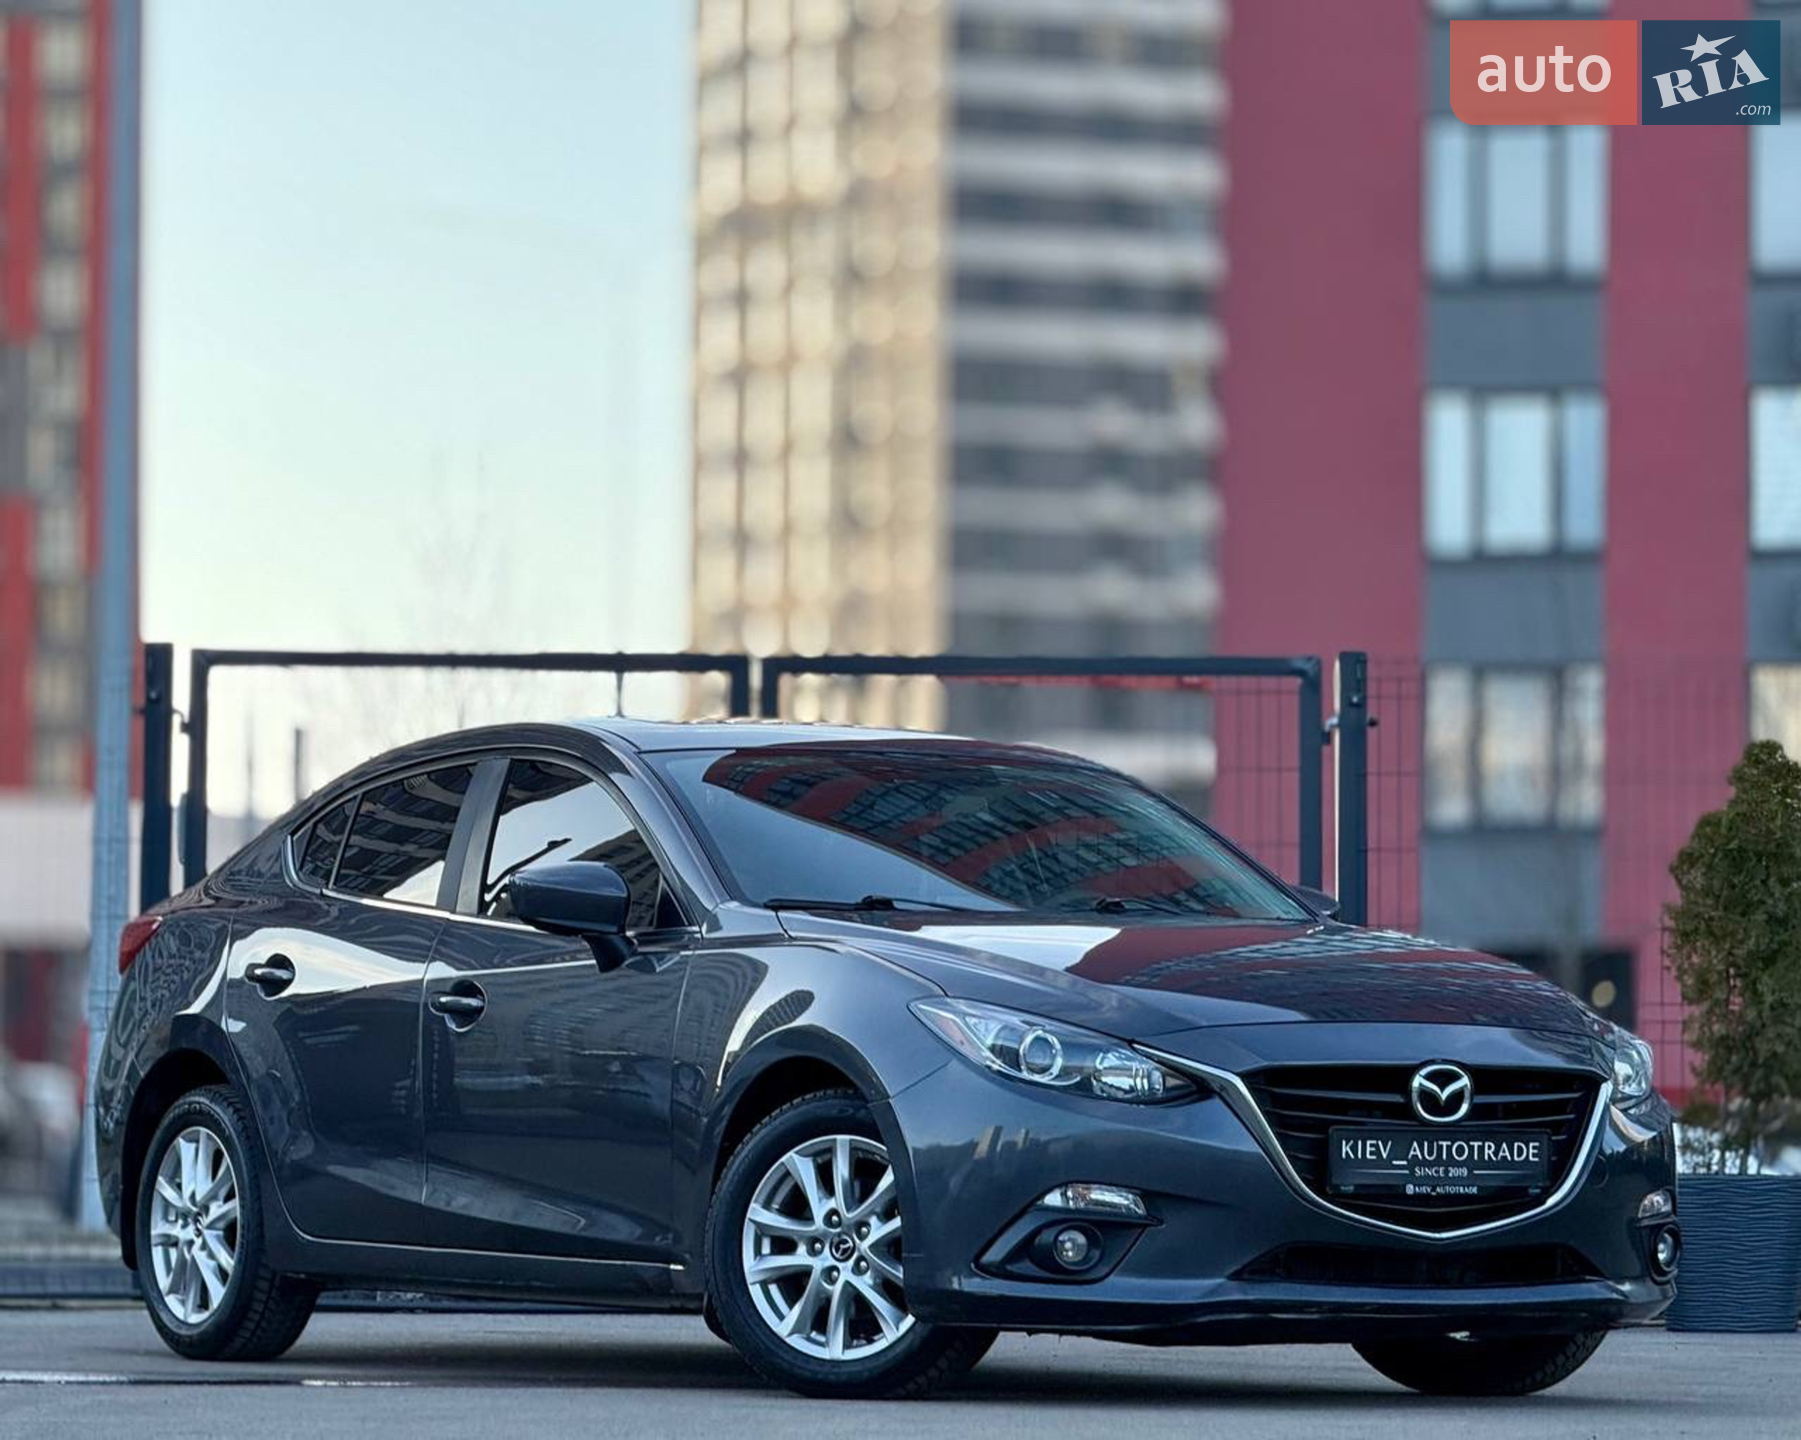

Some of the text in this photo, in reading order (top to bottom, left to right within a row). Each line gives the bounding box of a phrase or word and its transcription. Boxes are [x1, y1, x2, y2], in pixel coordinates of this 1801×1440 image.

[1341, 1139, 1540, 1165] KIEV_AUTOTRADE
[1414, 1166, 1468, 1177] SINCE 2019
